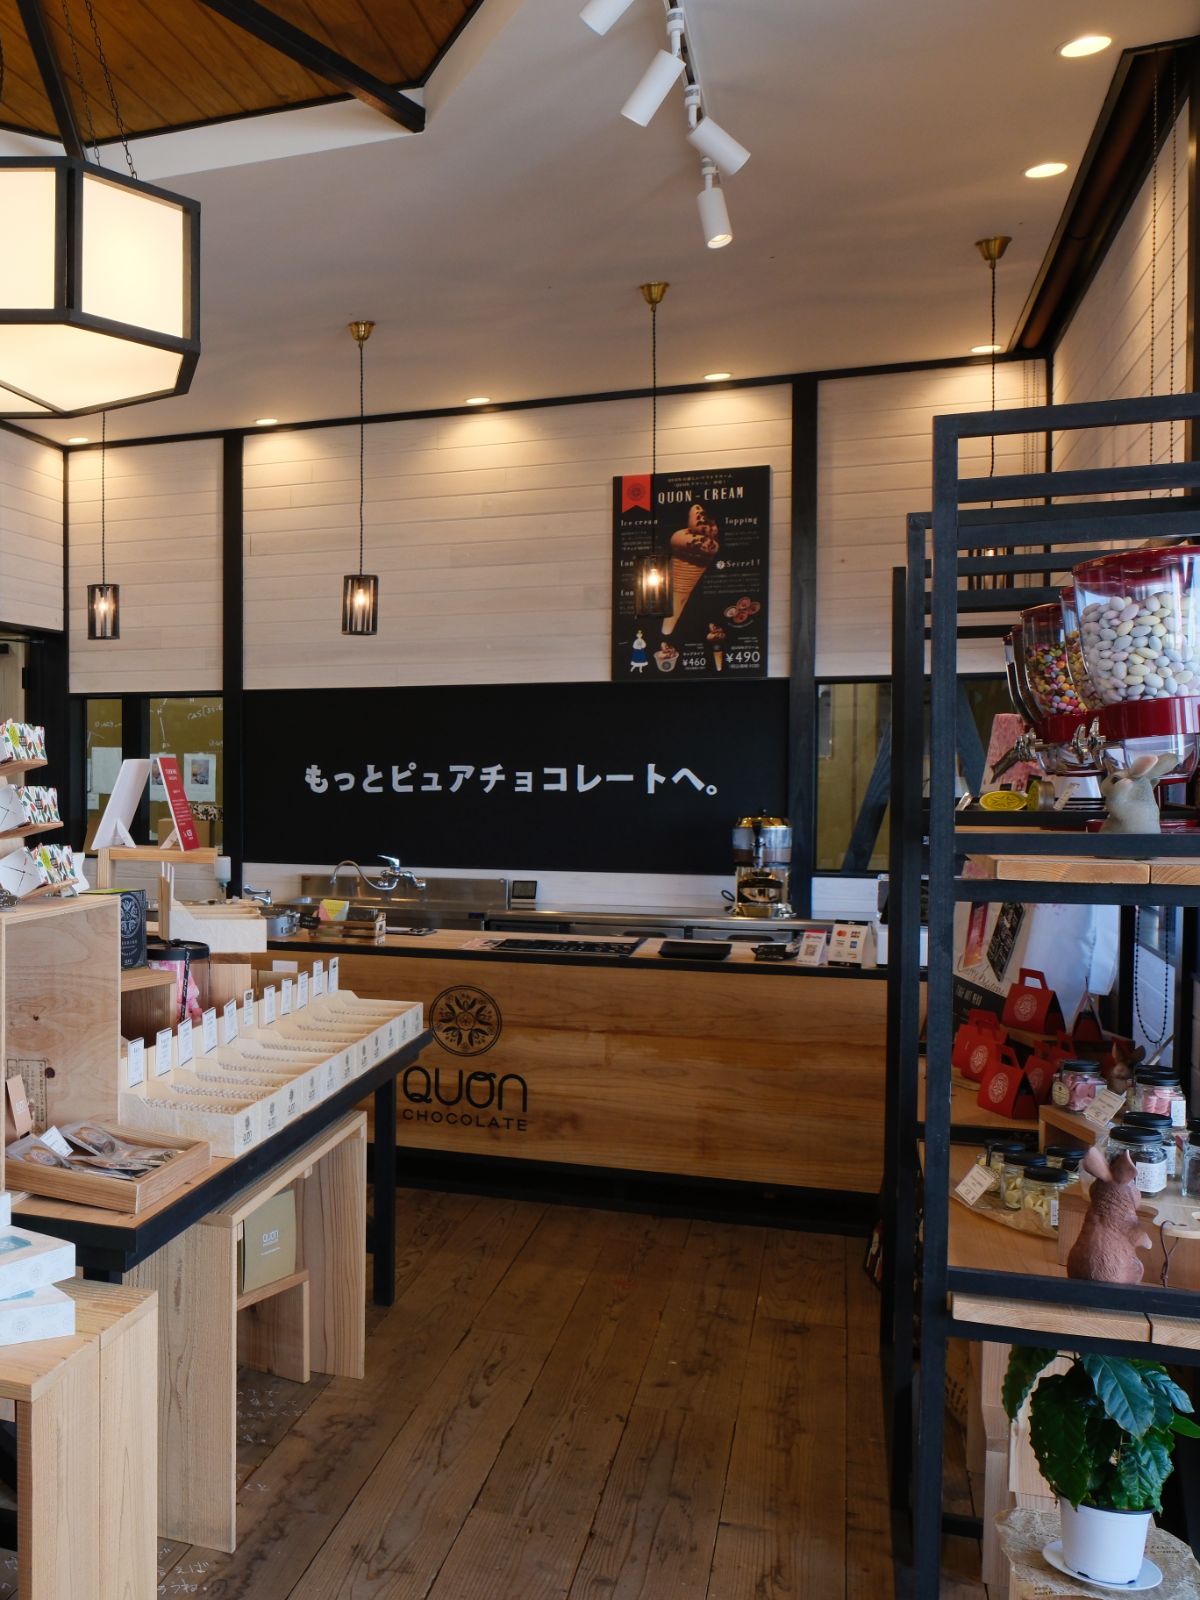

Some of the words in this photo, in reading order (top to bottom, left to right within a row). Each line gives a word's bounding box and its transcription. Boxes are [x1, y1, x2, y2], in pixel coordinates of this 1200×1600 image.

[658, 490, 692, 505] QUON
[704, 486, 744, 501] CREAM
[725, 516, 758, 526] Topping
[682, 657, 707, 666] ¥460
[725, 651, 761, 663] ¥490
[304, 761, 718, 796] もっとピュアチョコレートへ。
[402, 1108, 528, 1132] CHOCOLATE
